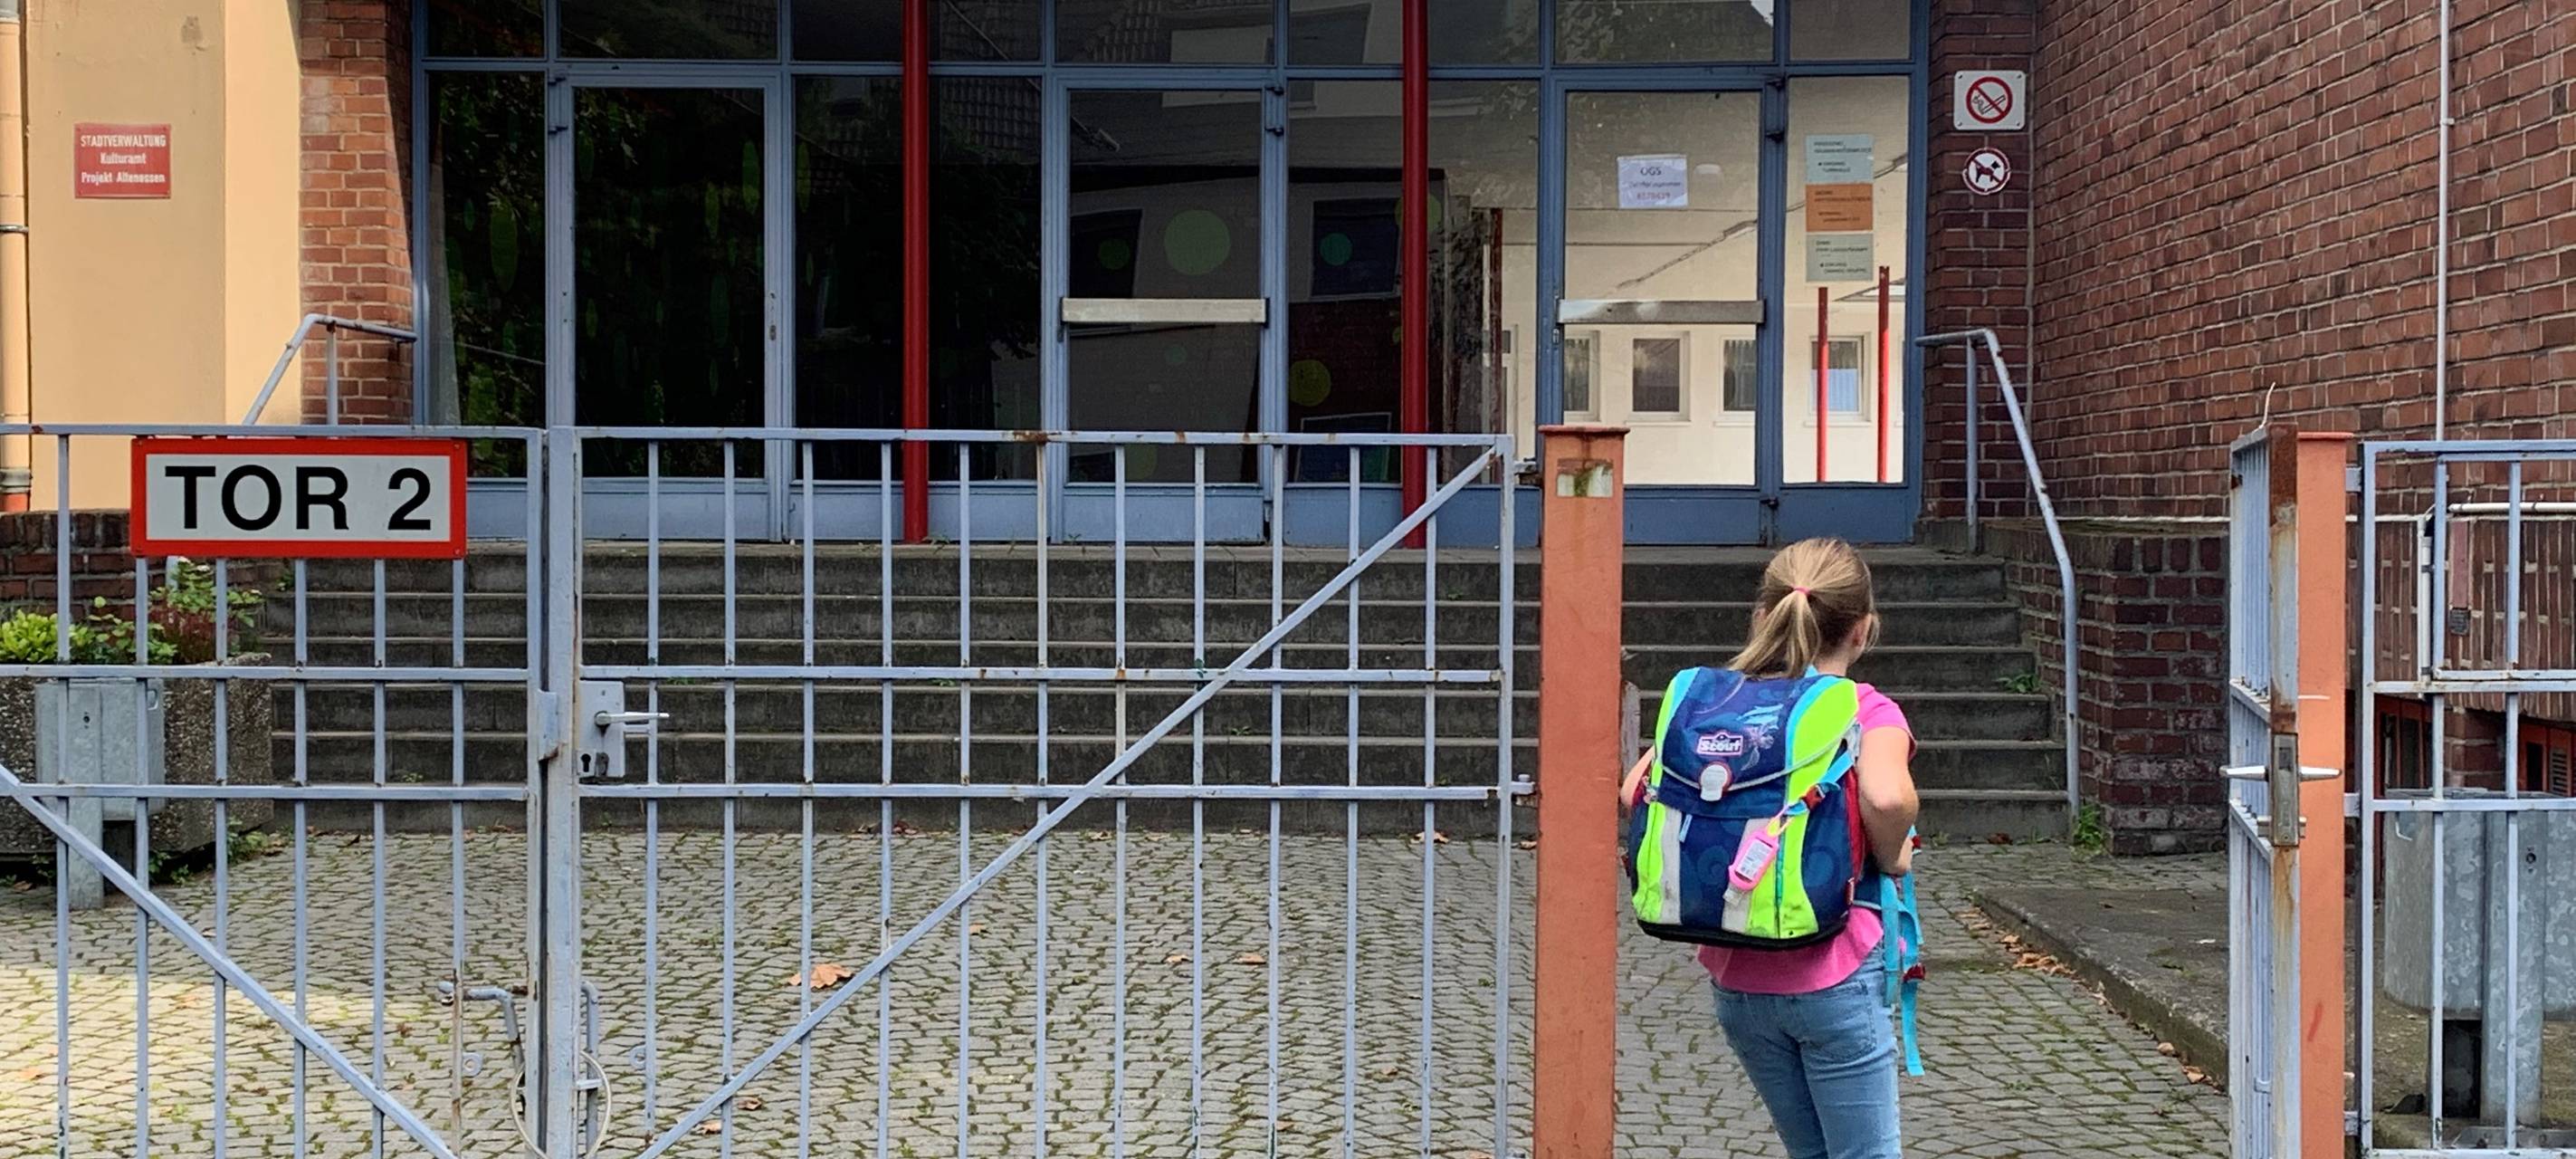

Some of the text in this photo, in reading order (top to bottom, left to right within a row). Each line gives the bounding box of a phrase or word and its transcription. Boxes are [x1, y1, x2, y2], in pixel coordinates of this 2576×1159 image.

[80, 135, 167, 147] STADTVERWALTUNG
[100, 152, 147, 164] Kulturamt
[1640, 167, 1662, 176] OGS
[81, 171, 166, 186] Projekt Altenessen
[165, 464, 432, 532] TOR 2
[1700, 739, 1741, 752] Scout
